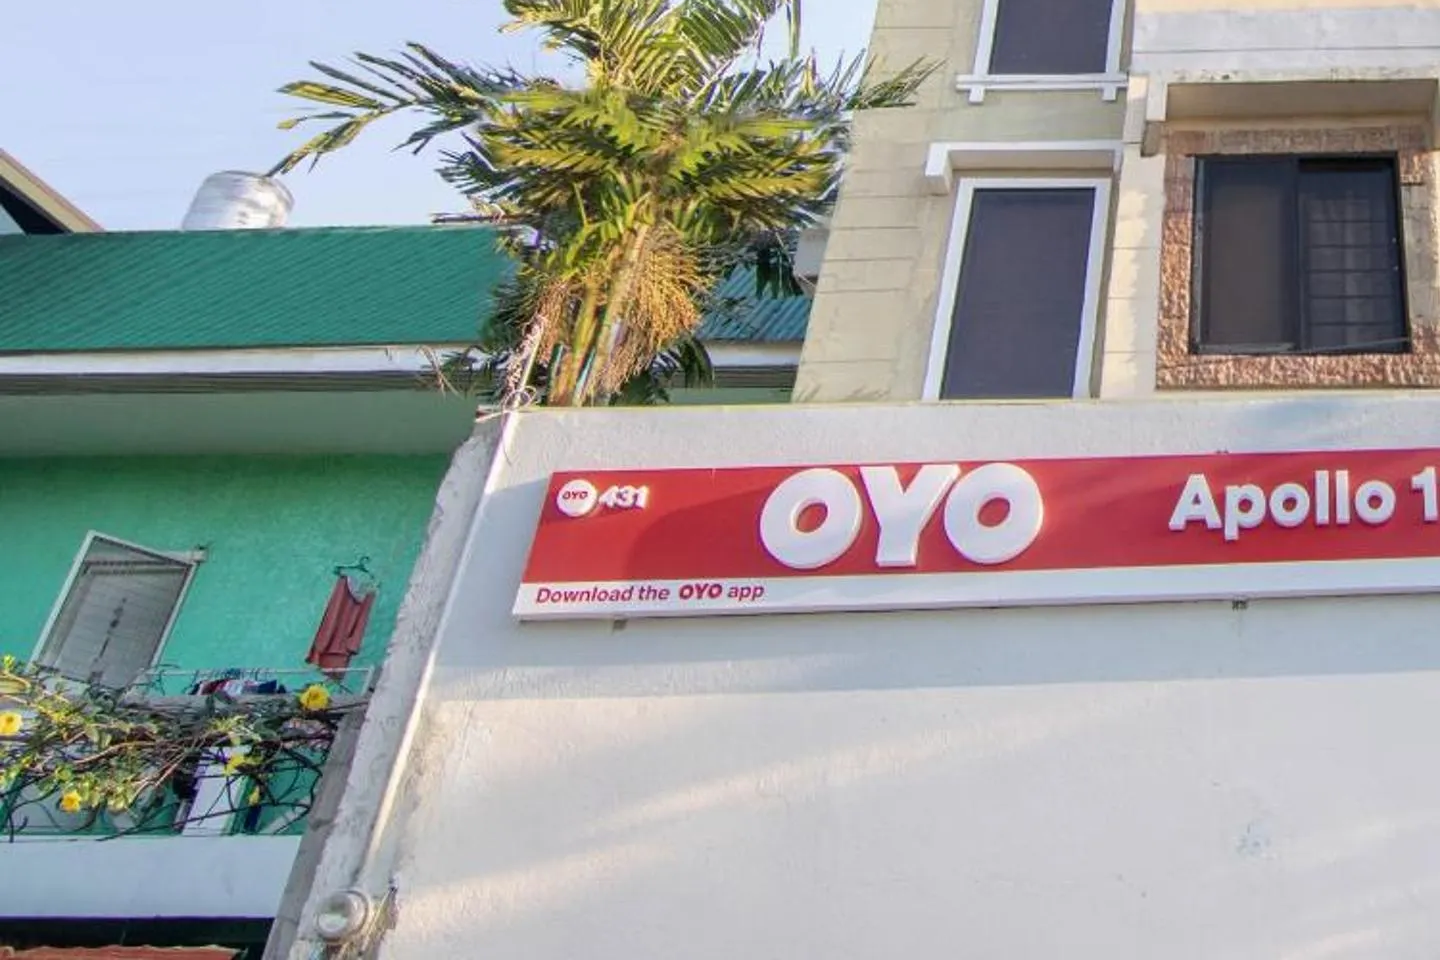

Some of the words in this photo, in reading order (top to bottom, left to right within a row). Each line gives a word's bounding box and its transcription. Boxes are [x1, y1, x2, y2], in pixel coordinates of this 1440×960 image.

[562, 491, 589, 500] OYO
[599, 485, 649, 509] 431
[760, 462, 1044, 570] OYO
[1168, 470, 1397, 541] Apollo
[535, 586, 633, 604] Download
[637, 585, 671, 601] the
[678, 583, 723, 601] OYO
[727, 583, 764, 601] app
